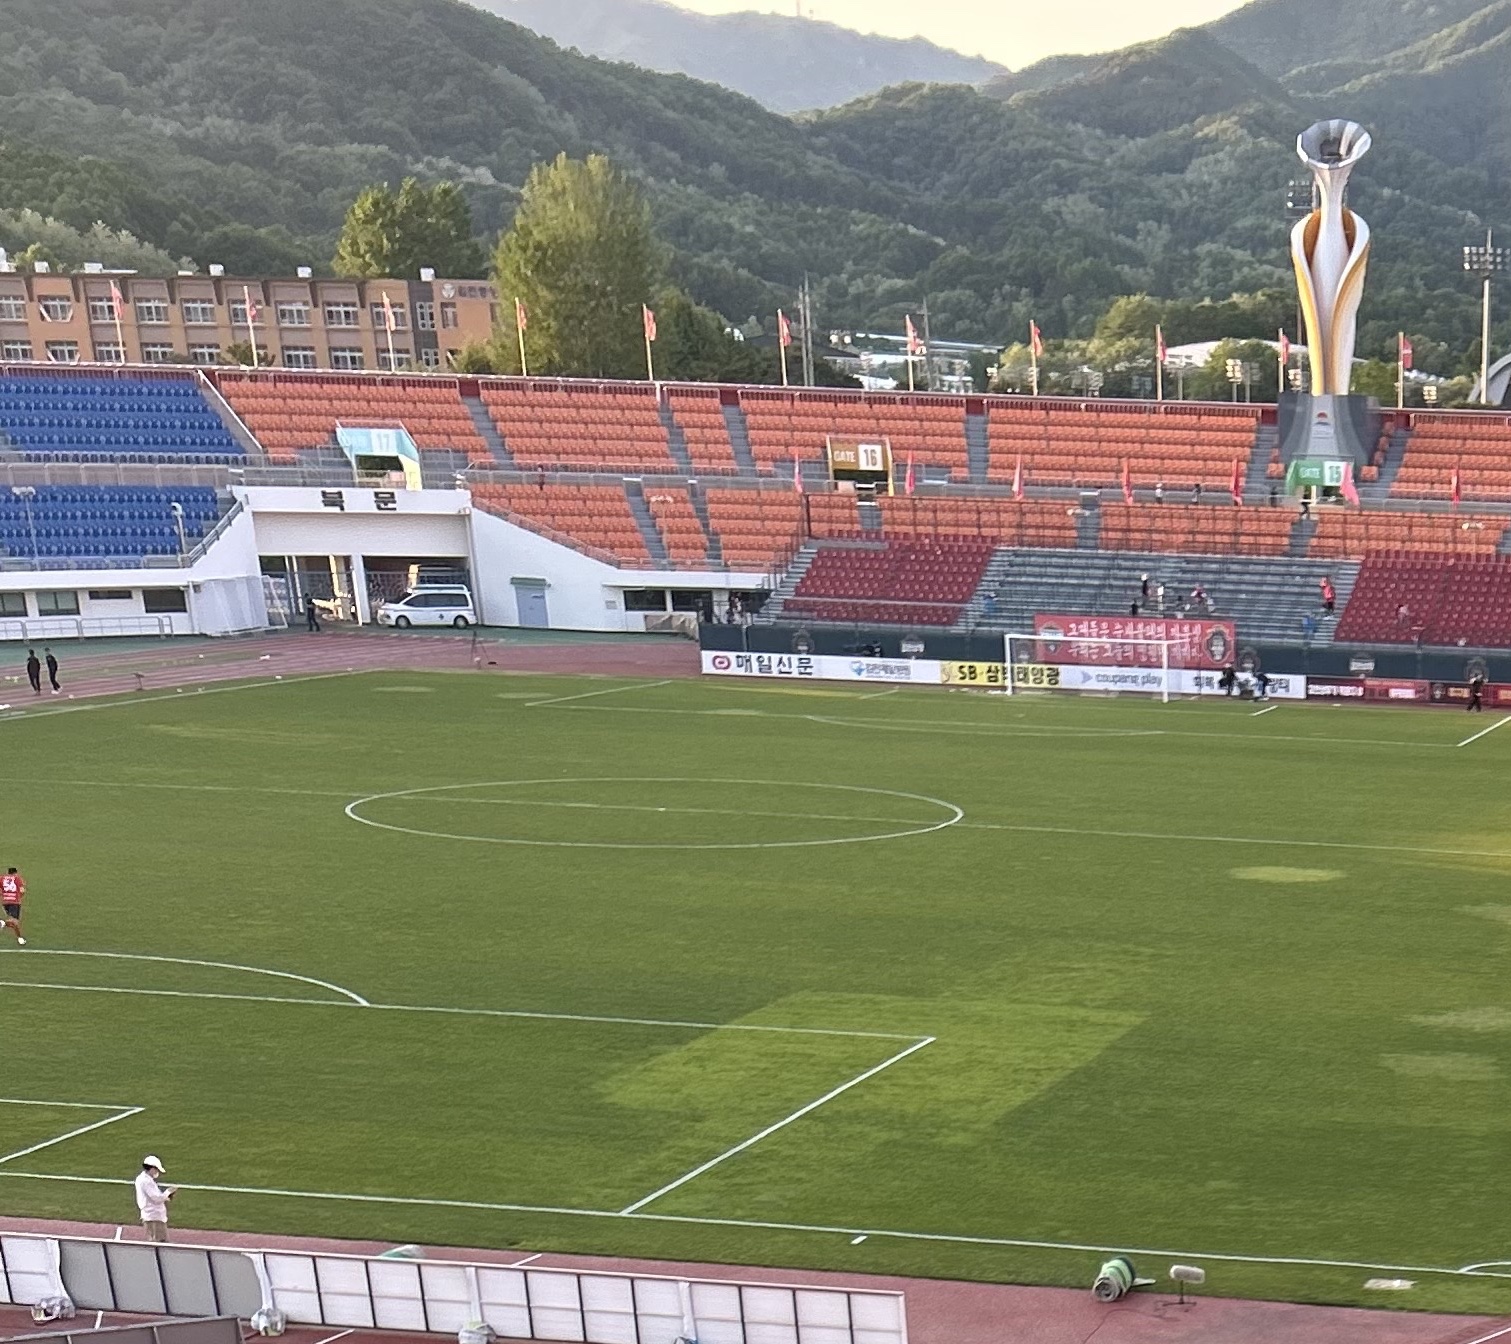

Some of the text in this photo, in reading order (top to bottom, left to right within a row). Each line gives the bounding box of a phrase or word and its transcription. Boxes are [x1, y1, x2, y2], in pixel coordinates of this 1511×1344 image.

[833, 449, 878, 467] GATE 16
[736, 654, 815, 675] 매일신문
